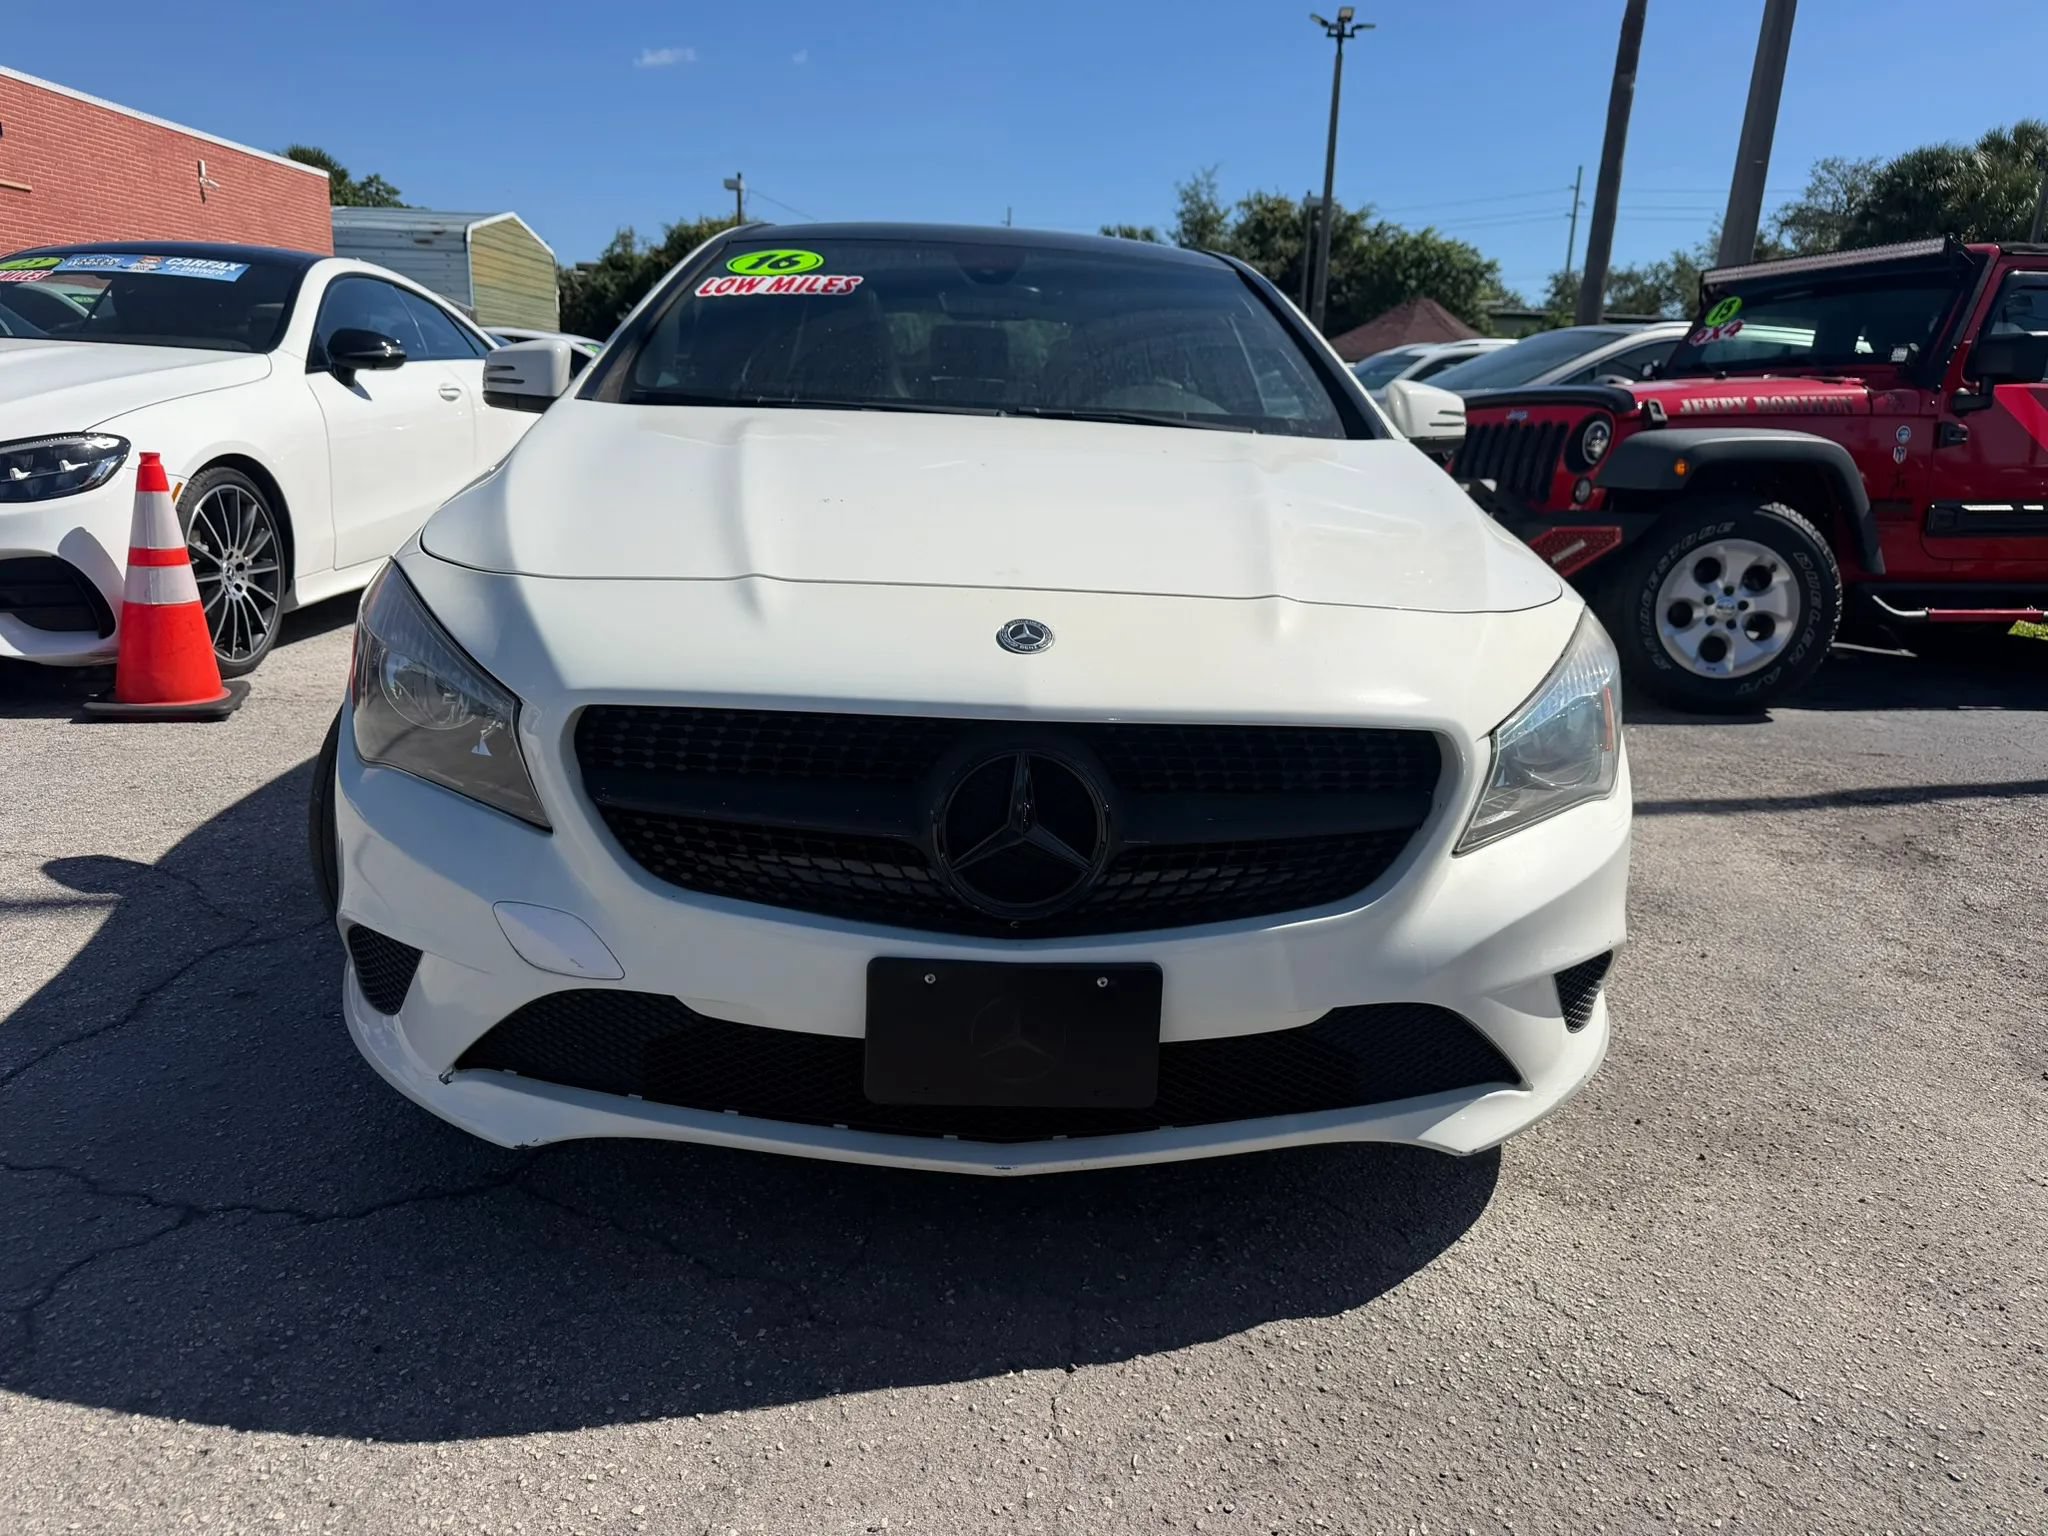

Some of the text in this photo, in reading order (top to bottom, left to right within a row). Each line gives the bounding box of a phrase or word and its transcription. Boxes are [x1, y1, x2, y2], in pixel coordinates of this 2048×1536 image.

[165, 257, 243, 272] CARFAX
[745, 254, 804, 270] 16
[699, 276, 863, 294] LOW MILES
